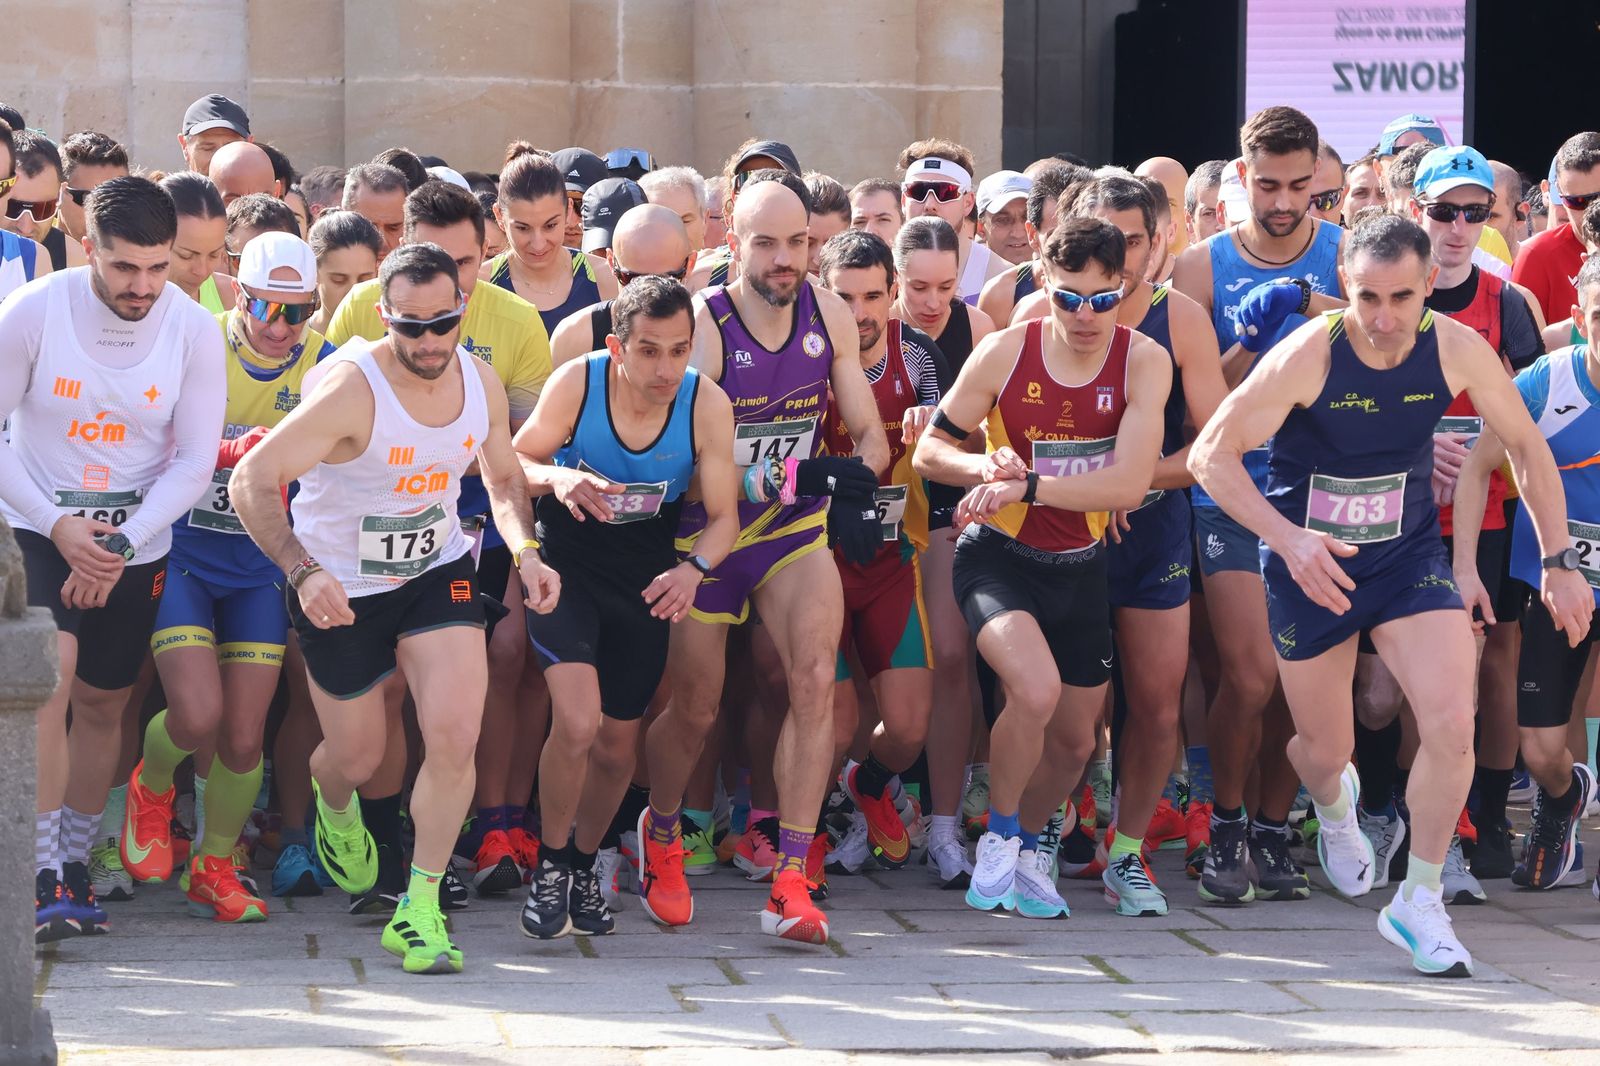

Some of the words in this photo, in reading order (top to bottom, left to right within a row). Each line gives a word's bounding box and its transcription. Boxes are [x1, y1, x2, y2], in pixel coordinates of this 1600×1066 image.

[732, 394, 768, 407] Jamón
[785, 394, 819, 409] PRIM
[749, 437, 800, 463] 147
[212, 486, 236, 513] 3
[601, 493, 644, 512] 33
[1328, 495, 1386, 523] 763
[380, 528, 435, 560] 173
[1004, 539, 1054, 564] NIKE
[1056, 547, 1098, 565] PRO
[1576, 541, 1600, 566] 2
